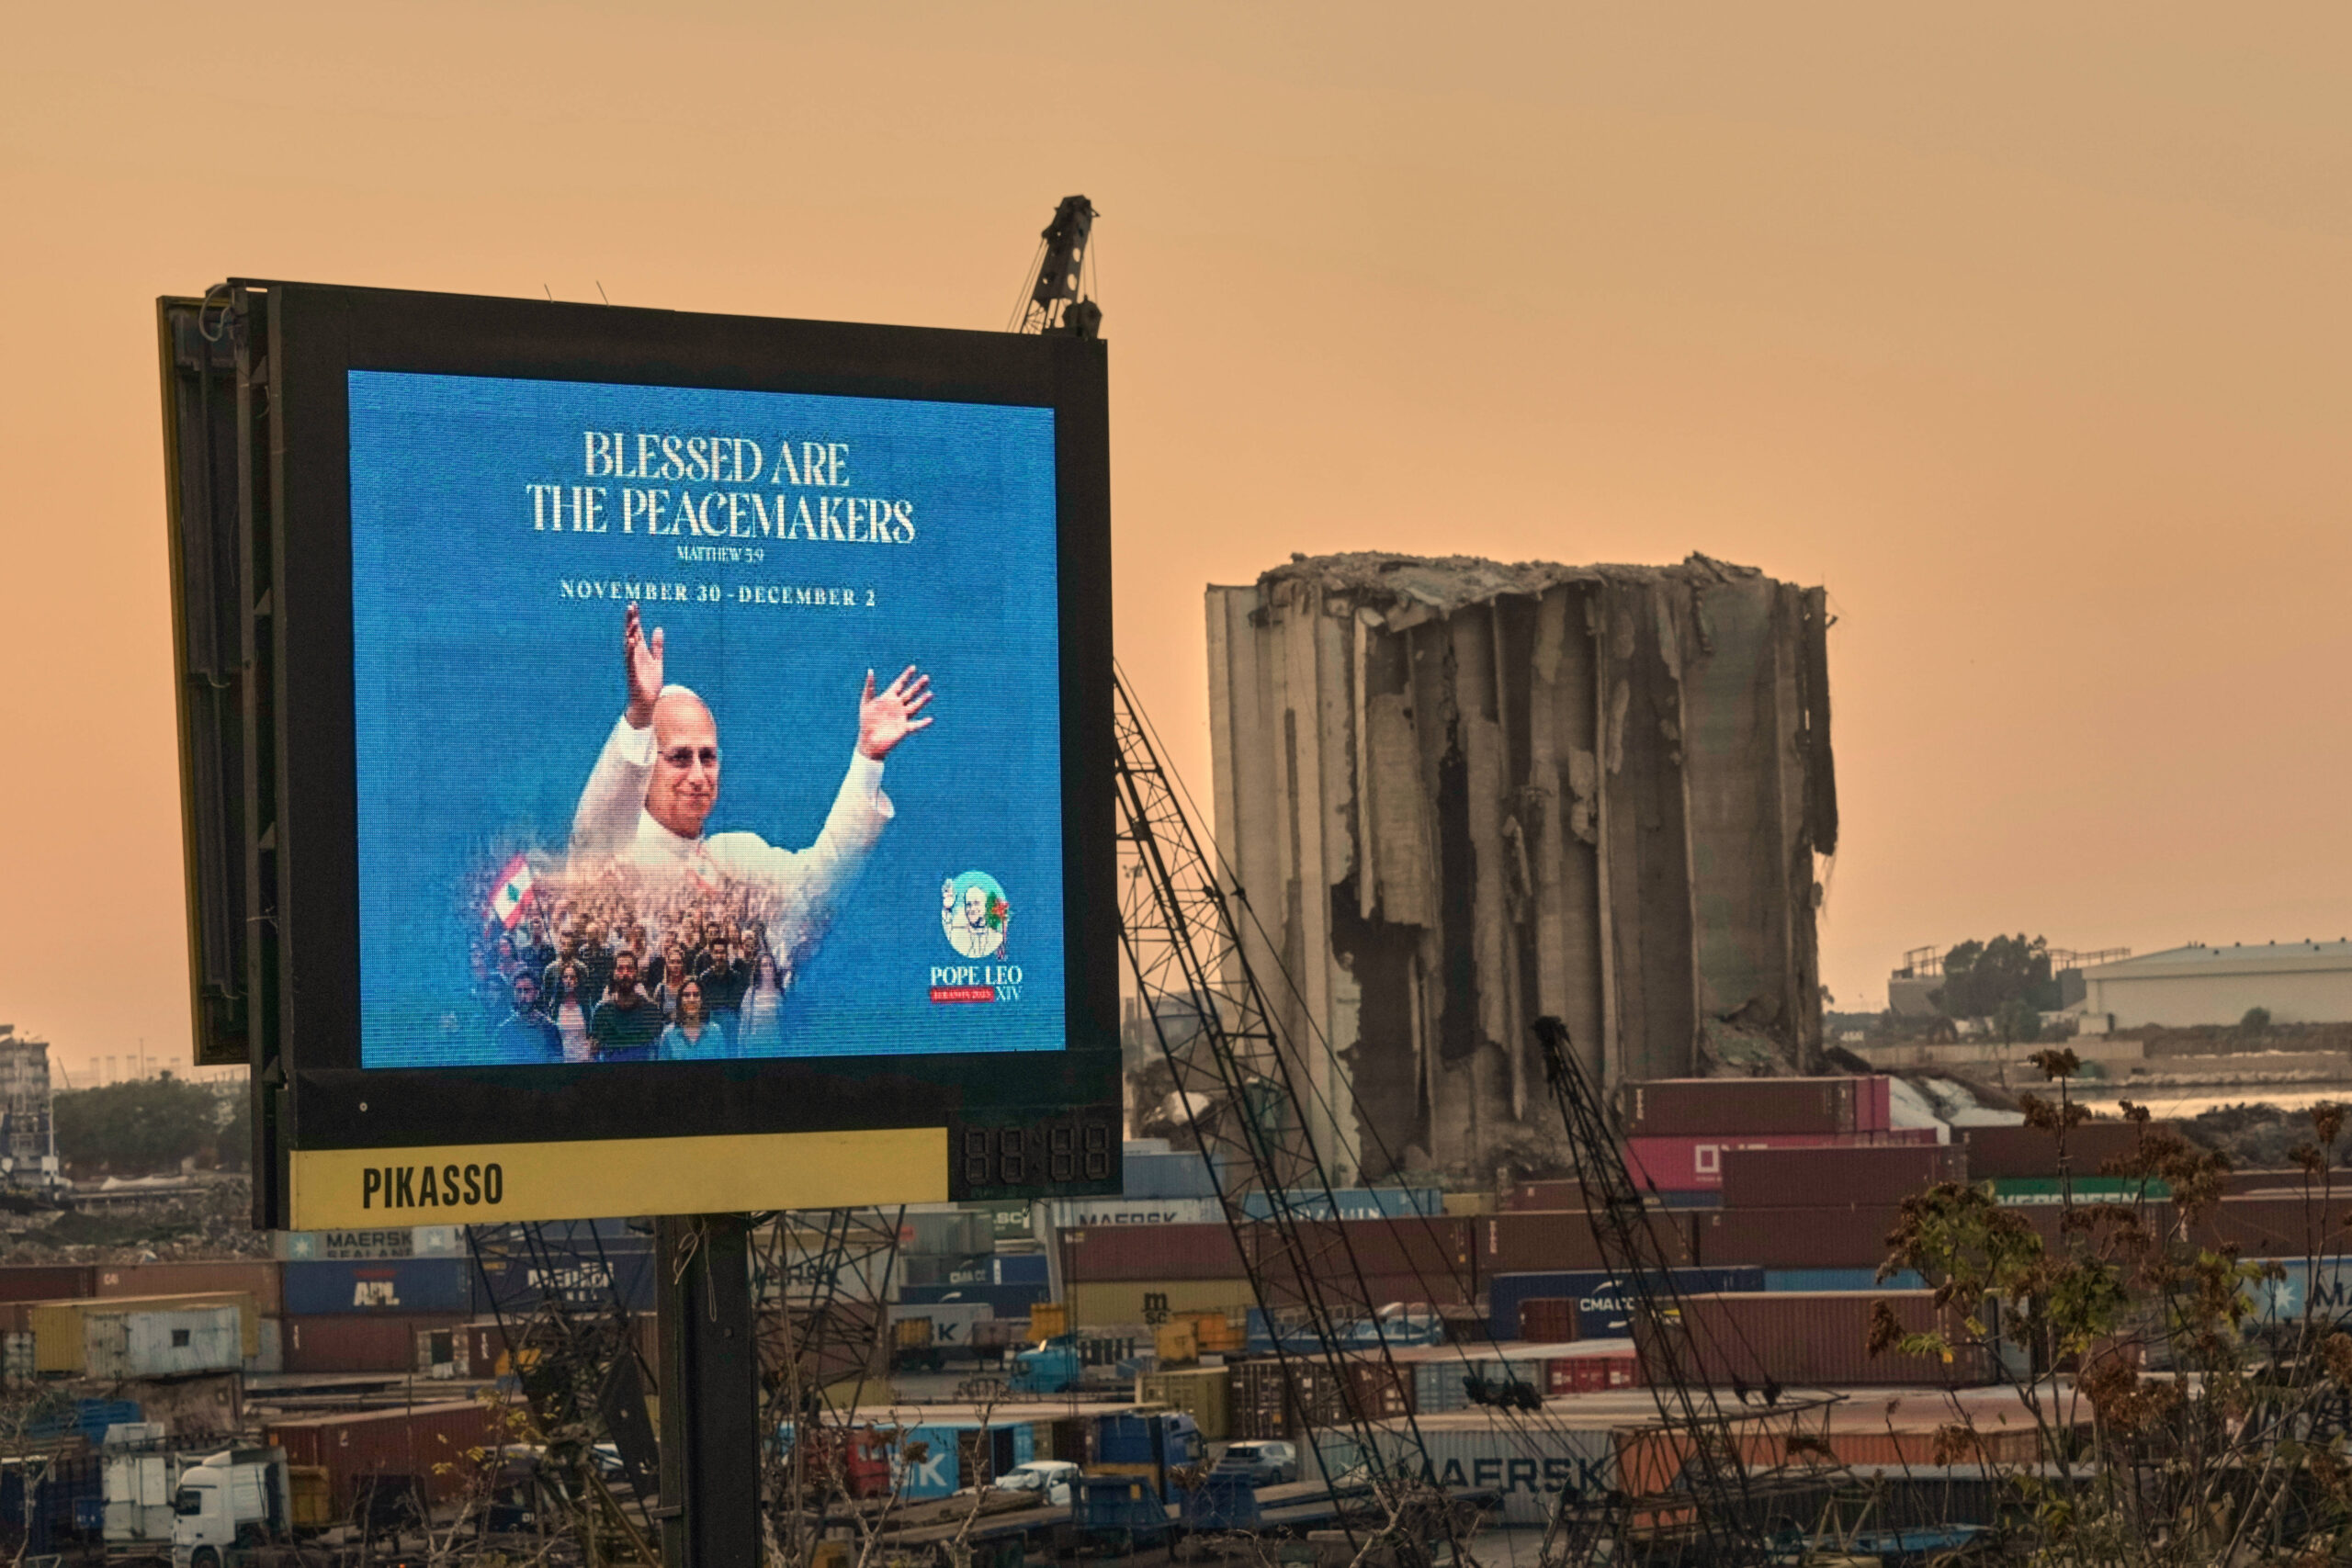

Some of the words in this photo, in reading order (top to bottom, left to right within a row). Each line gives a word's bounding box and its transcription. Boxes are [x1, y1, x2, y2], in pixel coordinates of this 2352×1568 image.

[583, 431, 763, 482] BLESSED
[771, 441, 851, 487] ARE
[526, 484, 607, 534] THE
[622, 488, 916, 544] PEACEMAKERS
[677, 546, 742, 561] MATTHEW
[560, 580, 689, 601] NOVEMBER
[739, 585, 856, 606] DECEMBER
[865, 590, 876, 607] 2
[931, 966, 980, 986] POPE
[985, 965, 1023, 985] LEO
[996, 986, 1023, 1002] XIV
[363, 1163, 503, 1209] PIKASSO
[326, 1230, 412, 1247] MAERSK
[1580, 1297, 1614, 1312] CMA
[2313, 1280, 2352, 1306] M
